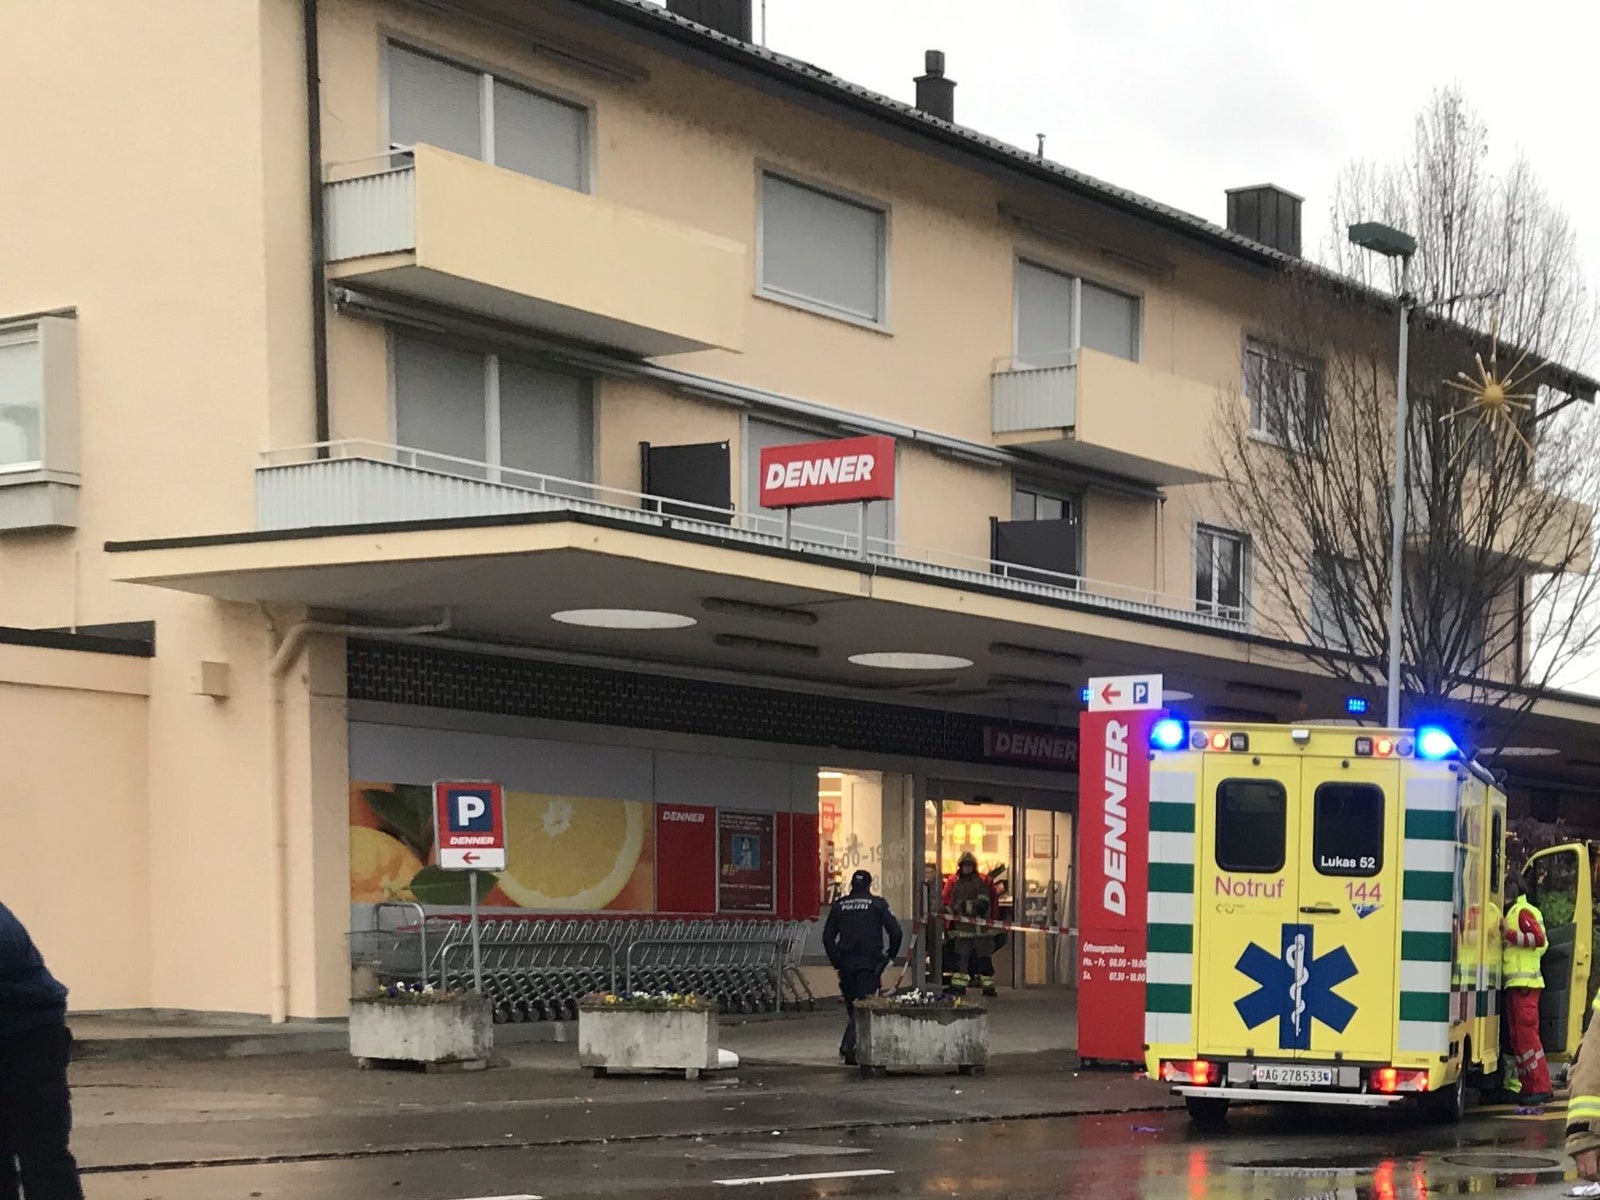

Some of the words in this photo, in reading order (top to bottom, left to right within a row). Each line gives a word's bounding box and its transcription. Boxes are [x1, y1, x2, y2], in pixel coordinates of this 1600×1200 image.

[765, 454, 874, 490] DENNER
[1135, 684, 1147, 702] P
[994, 731, 1078, 761] DENNER
[457, 795, 486, 827] P
[662, 811, 705, 823] DENNER
[1103, 719, 1129, 917] DENNER
[449, 836, 495, 845] DENNER
[1321, 855, 1357, 868] Lukas
[1359, 856, 1375, 869] 52
[1215, 875, 1285, 898] Notruf
[1345, 881, 1383, 902] 144
[1265, 1069, 1279, 1081] AG
[1281, 1069, 1324, 1082] 278533
